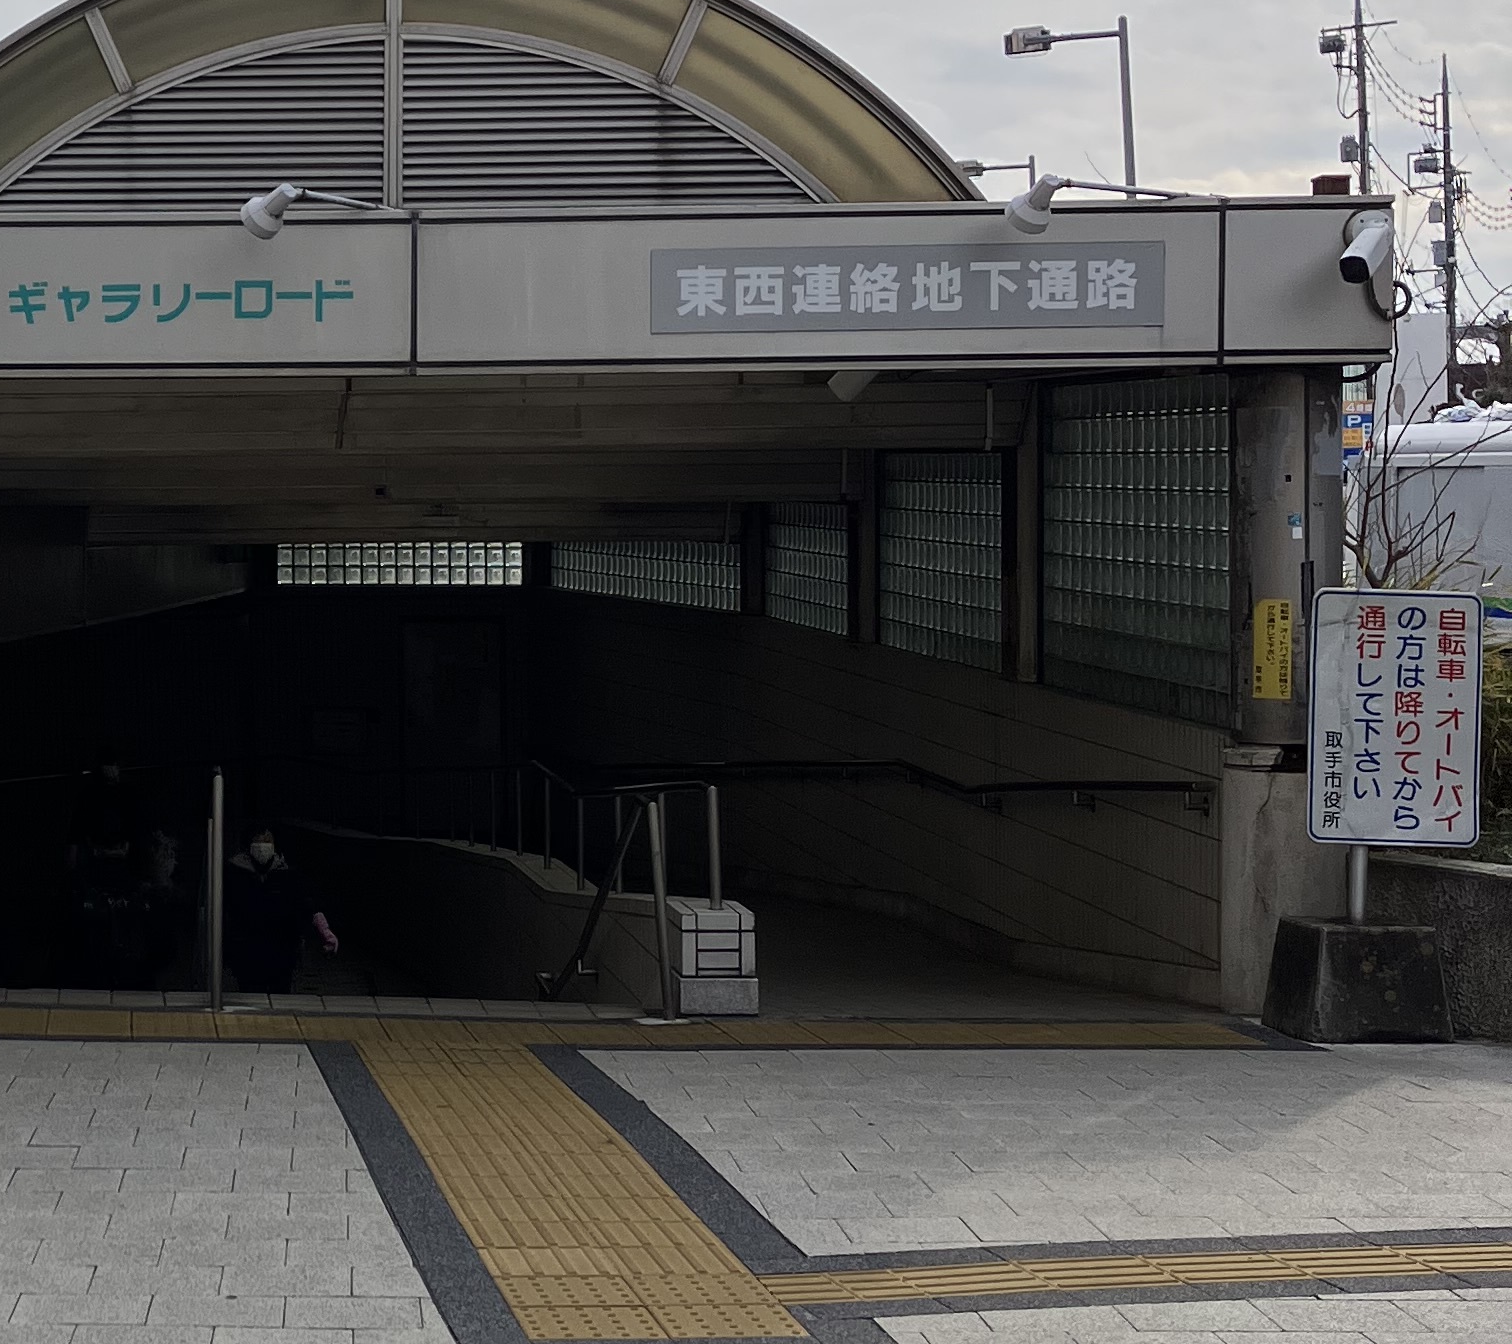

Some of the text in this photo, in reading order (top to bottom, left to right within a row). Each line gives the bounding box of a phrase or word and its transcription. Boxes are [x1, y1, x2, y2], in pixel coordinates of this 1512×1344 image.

[8, 279, 354, 324] ギャラリーロード
[676, 259, 1138, 316] 東西連絡地下通路
[1353, 606, 1387, 799] 通行して下さい
[1392, 606, 1427, 830] の方は降りてから
[1433, 608, 1467, 832] 自転車・オートバイ
[1322, 730, 1344, 829] 取手市役所
